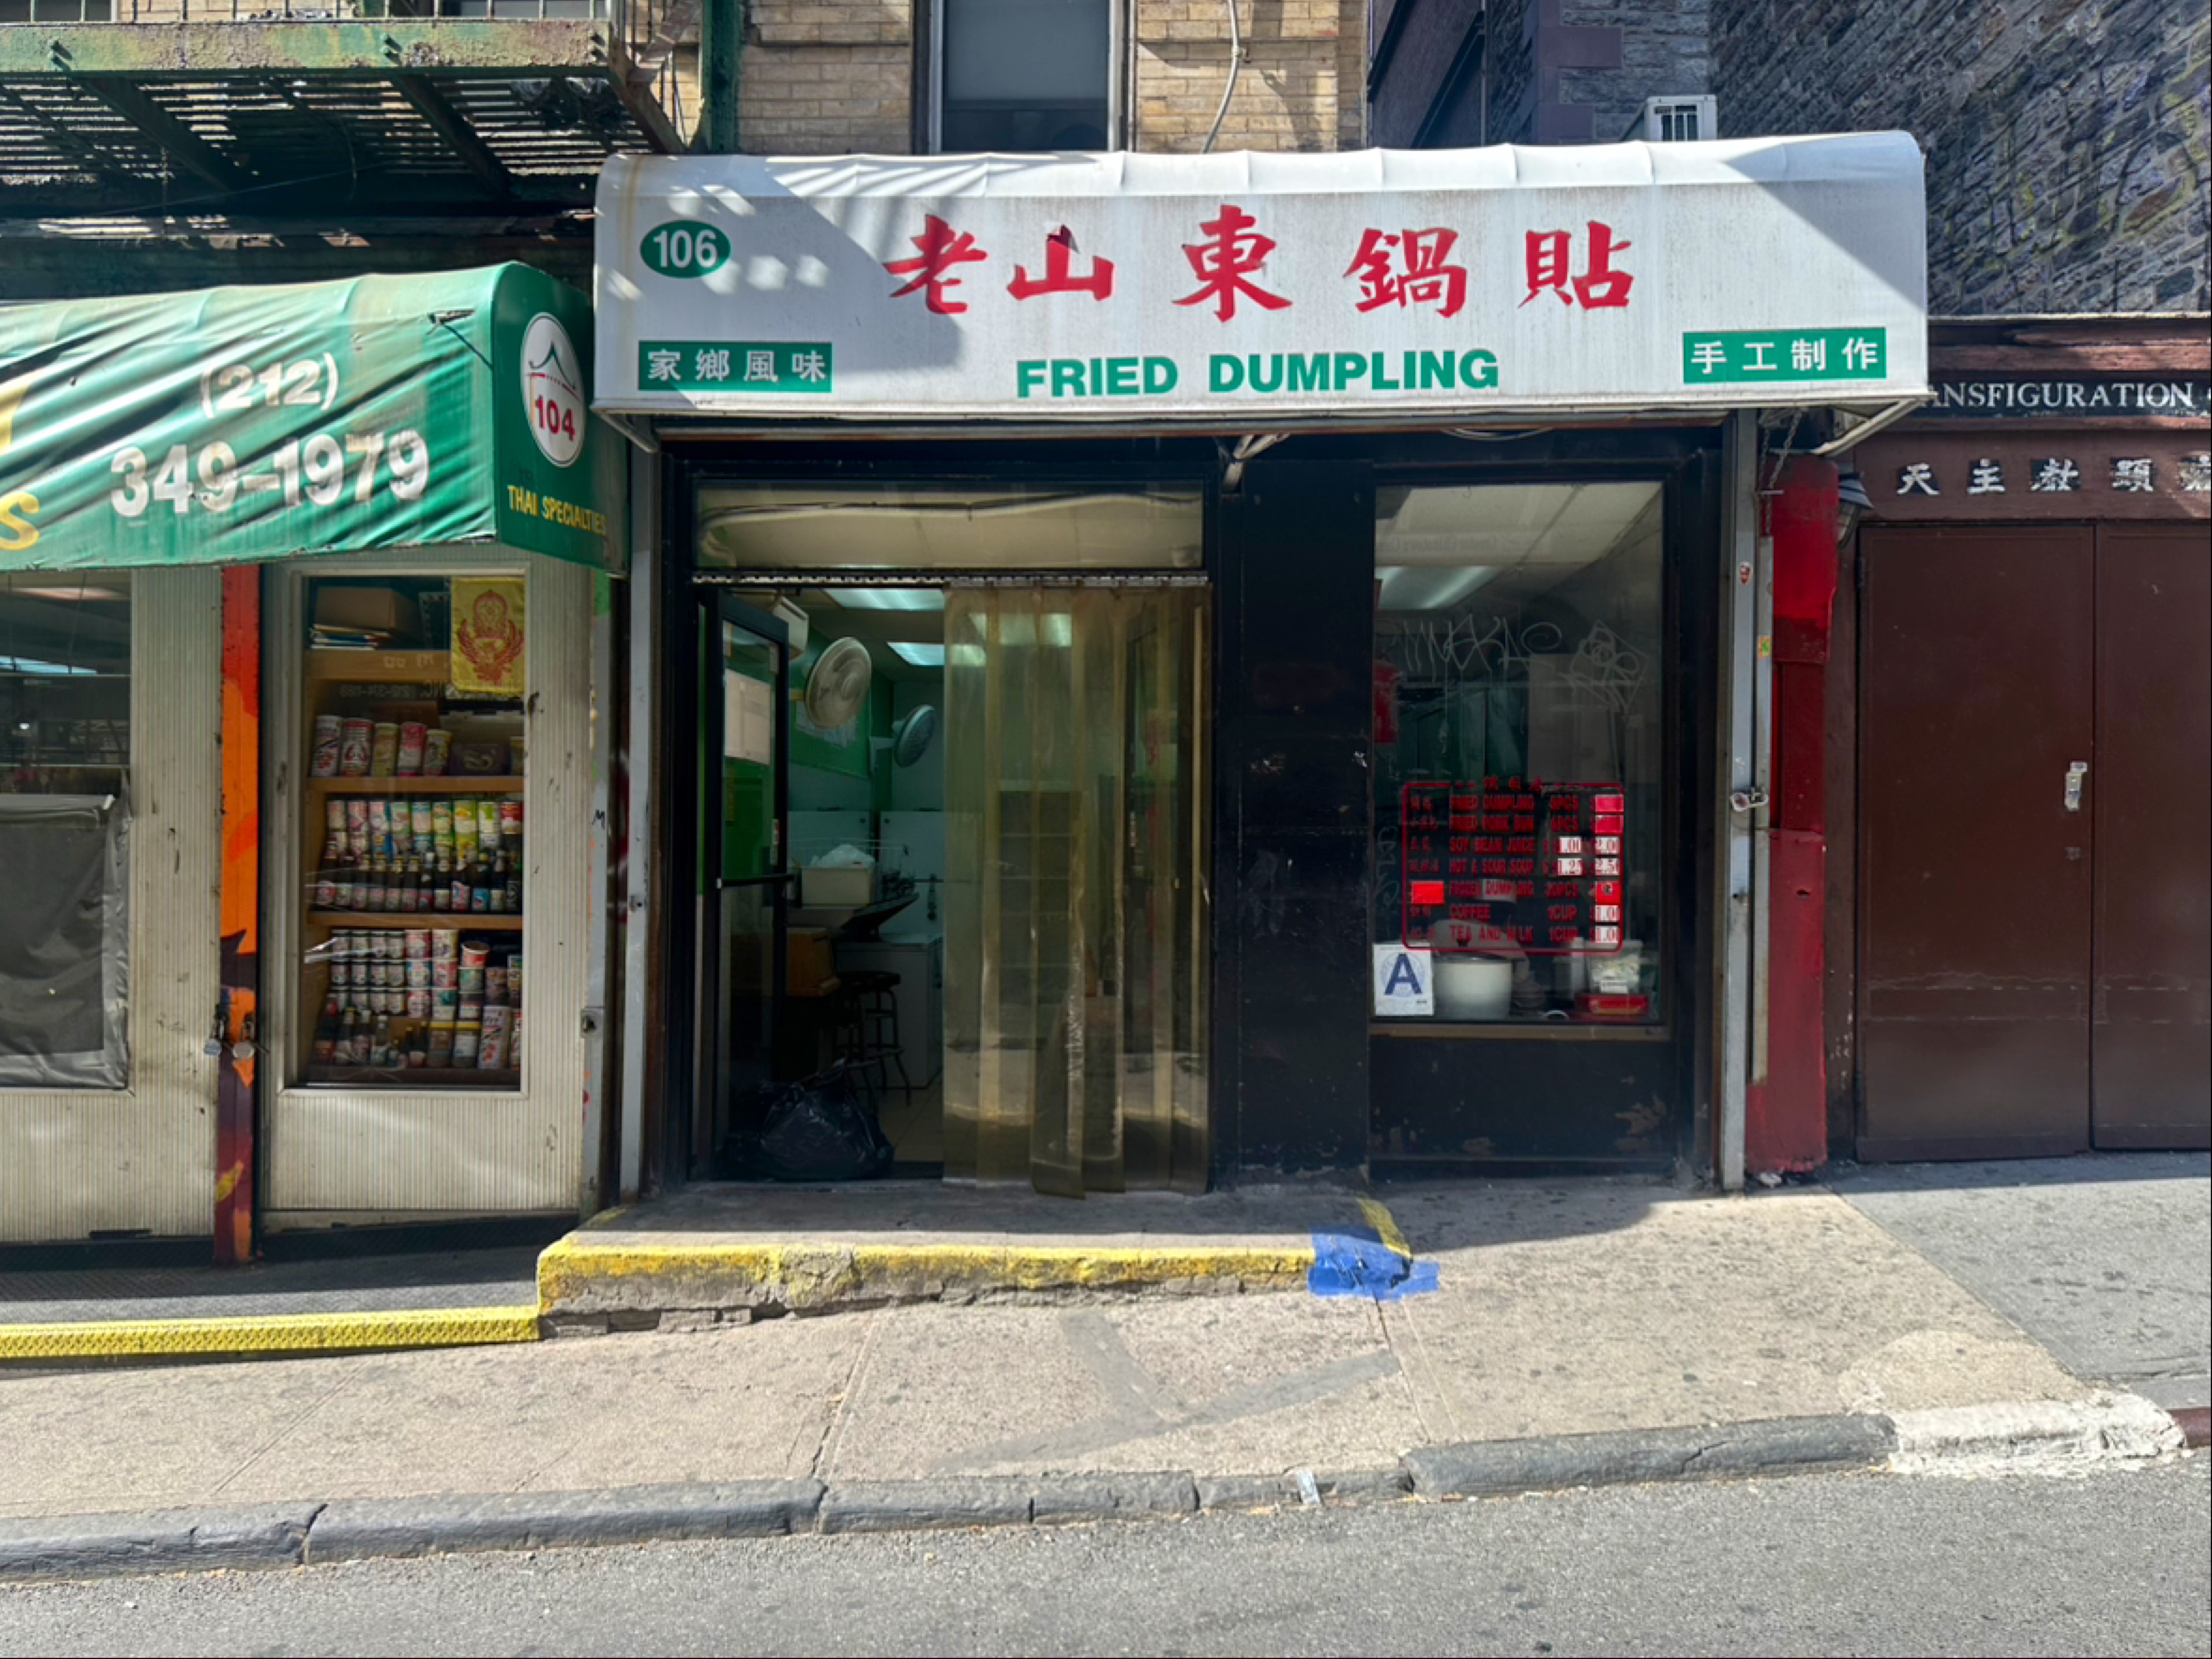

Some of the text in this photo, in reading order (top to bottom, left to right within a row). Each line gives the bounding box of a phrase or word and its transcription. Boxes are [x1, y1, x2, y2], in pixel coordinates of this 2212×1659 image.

[654, 229, 718, 269] 106
[882, 204, 1634, 323] 老山東鍋貼
[647, 348, 830, 383] 家鄉風味
[1016, 349, 1499, 398] FRIED DUMPLING
[1690, 338, 1879, 374] 手工制作
[200, 353, 340, 419] (212)
[535, 393, 577, 442] 104
[110, 429, 432, 518] 349-1979
[507, 485, 607, 536] THAI SPECIALTIES
[1384, 953, 1423, 996] A
